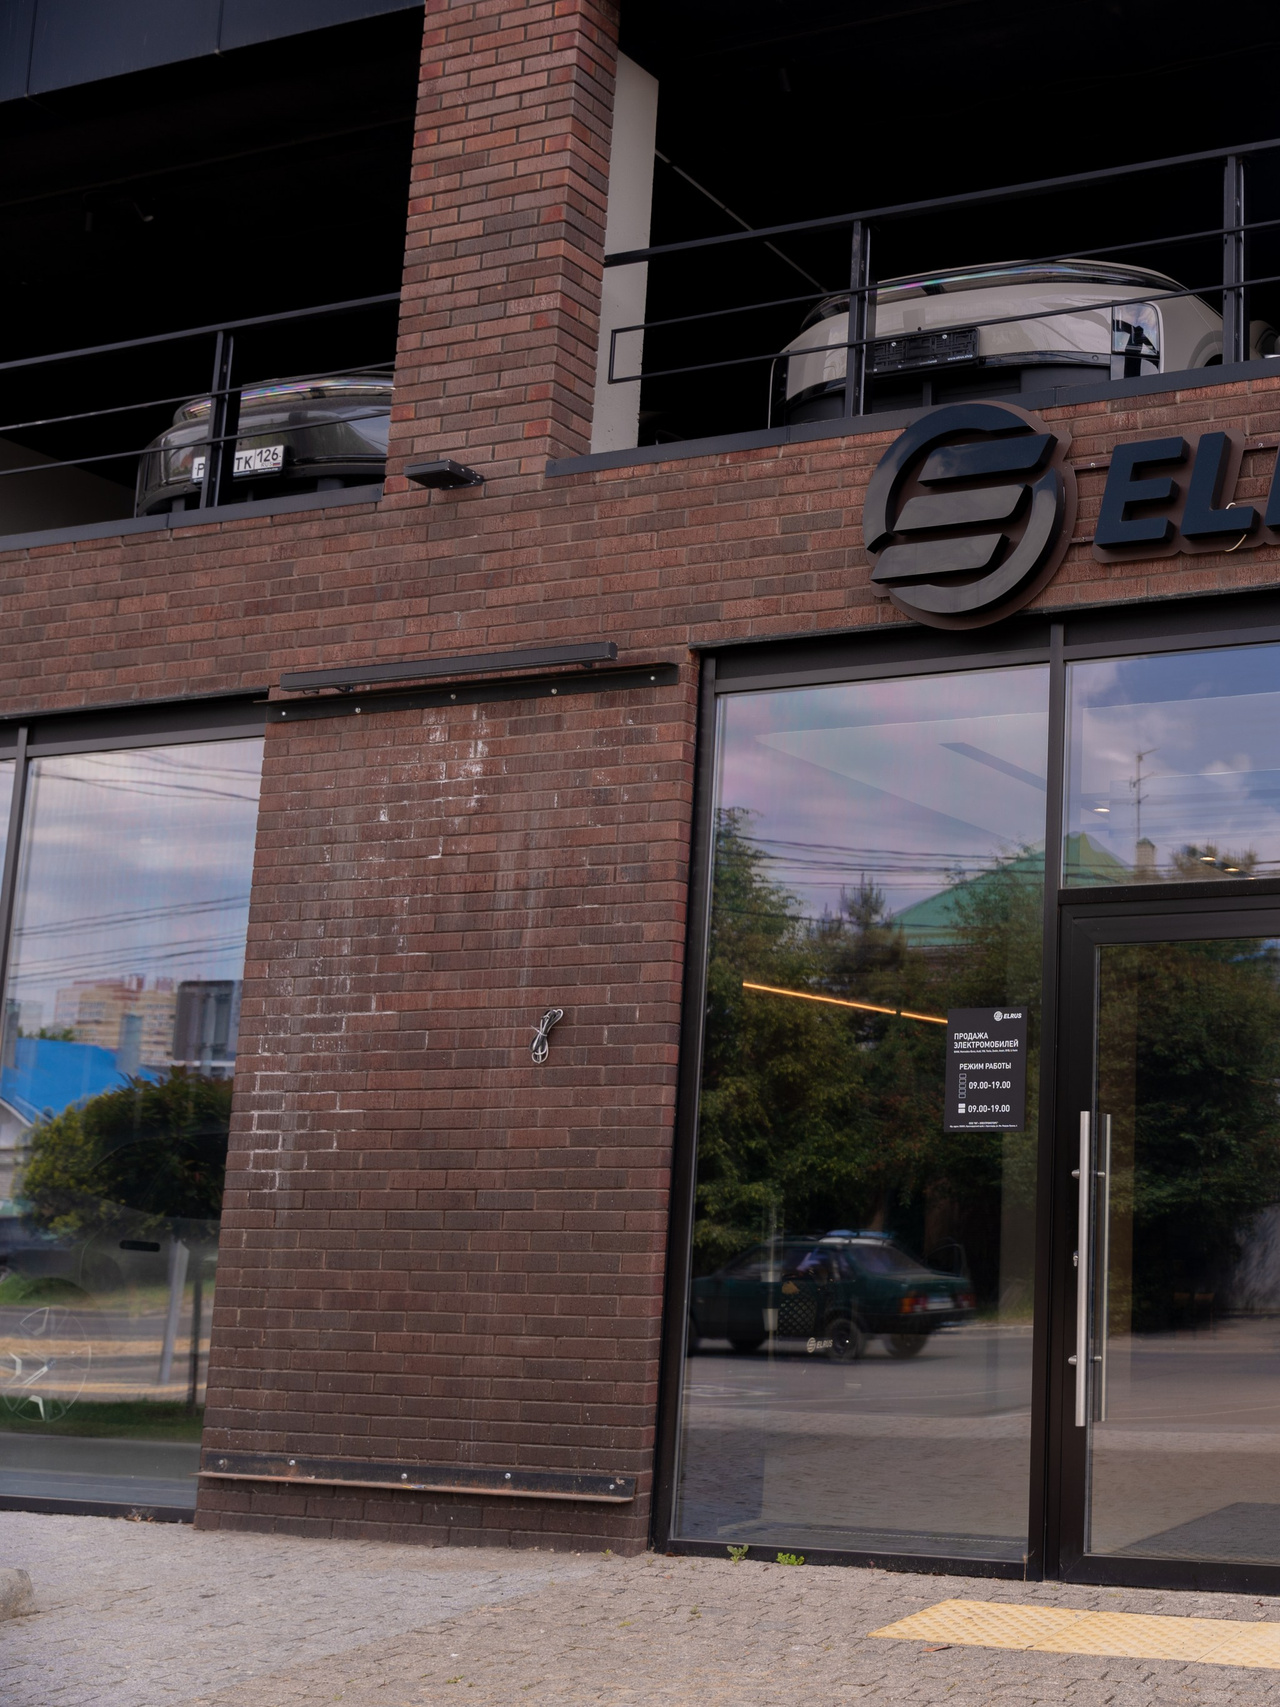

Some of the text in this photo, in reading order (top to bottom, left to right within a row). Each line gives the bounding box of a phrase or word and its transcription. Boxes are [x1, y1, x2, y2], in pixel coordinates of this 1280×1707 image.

[256, 447, 279, 463] 126
[1003, 1012, 1022, 1020] ELRUS
[954, 1032, 989, 1041] ПРОДАЖА
[953, 1039, 1019, 1049] ЭЛЕКТРОМОБИЛЕЙ
[959, 1062, 1012, 1071] РЕЖИМ РАБОТЫ
[968, 1081, 1011, 1090] 09.00-19.00
[967, 1104, 1010, 1113] 09.00-19.00
